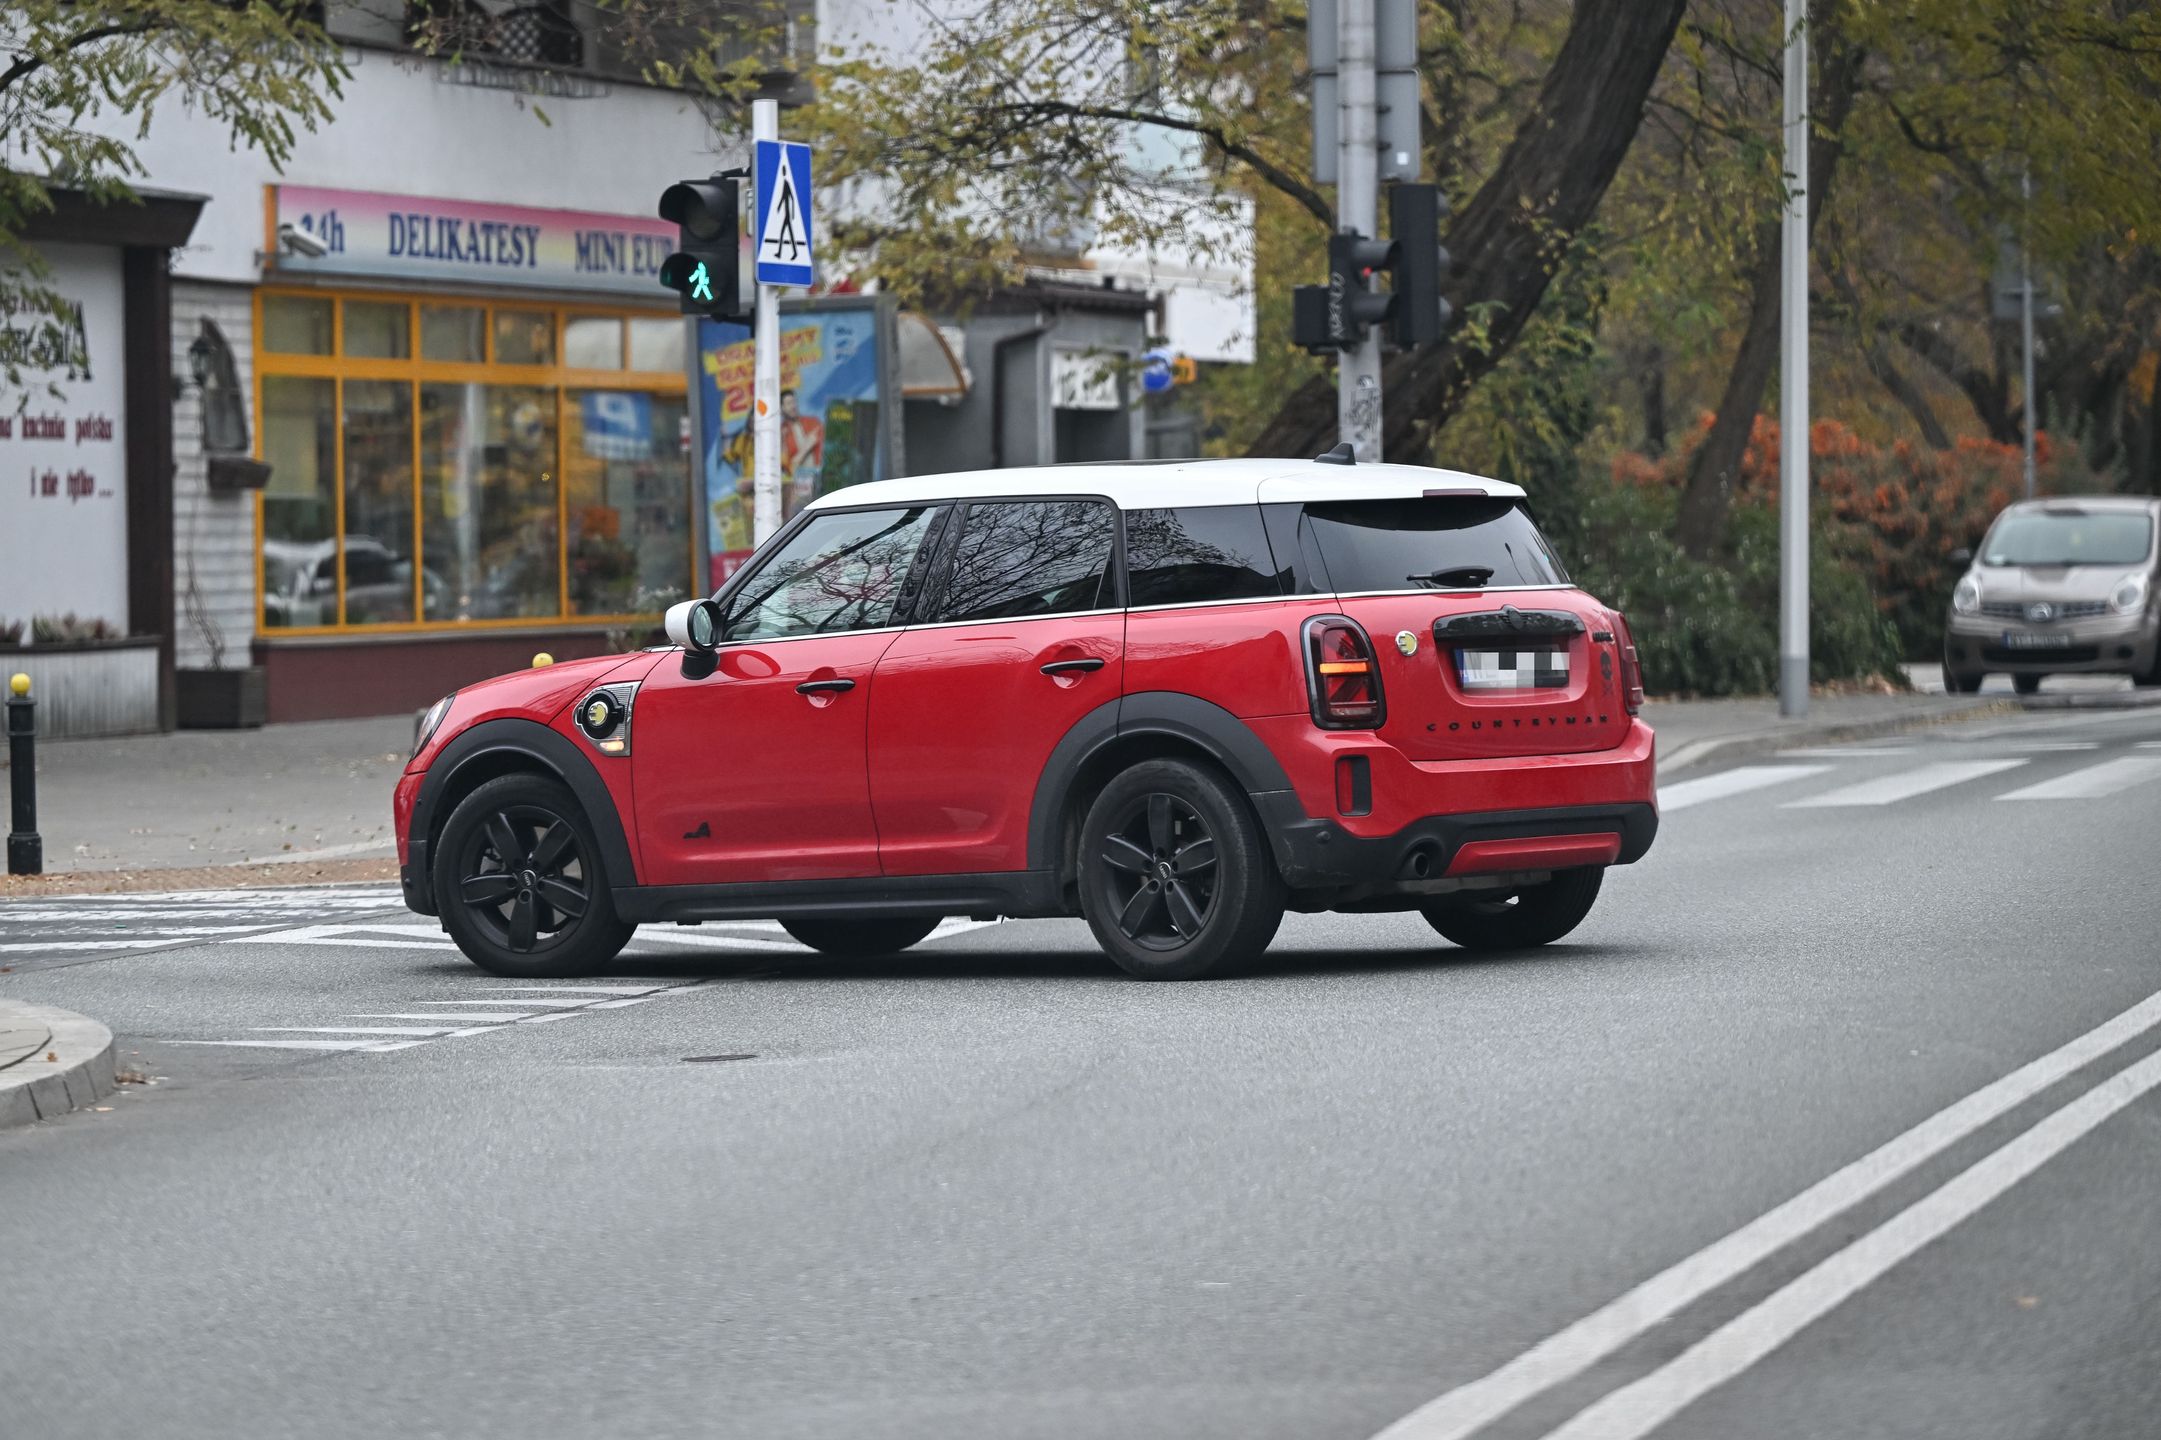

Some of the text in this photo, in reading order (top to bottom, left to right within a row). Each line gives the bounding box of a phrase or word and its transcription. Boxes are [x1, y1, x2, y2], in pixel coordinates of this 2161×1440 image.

[388, 211, 541, 268] DELIKATESY
[574, 229, 626, 275] MINI
[75, 411, 113, 447] polska
[41, 467, 59, 497] nie
[1426, 714, 1608, 732] COUNTRYMAN
